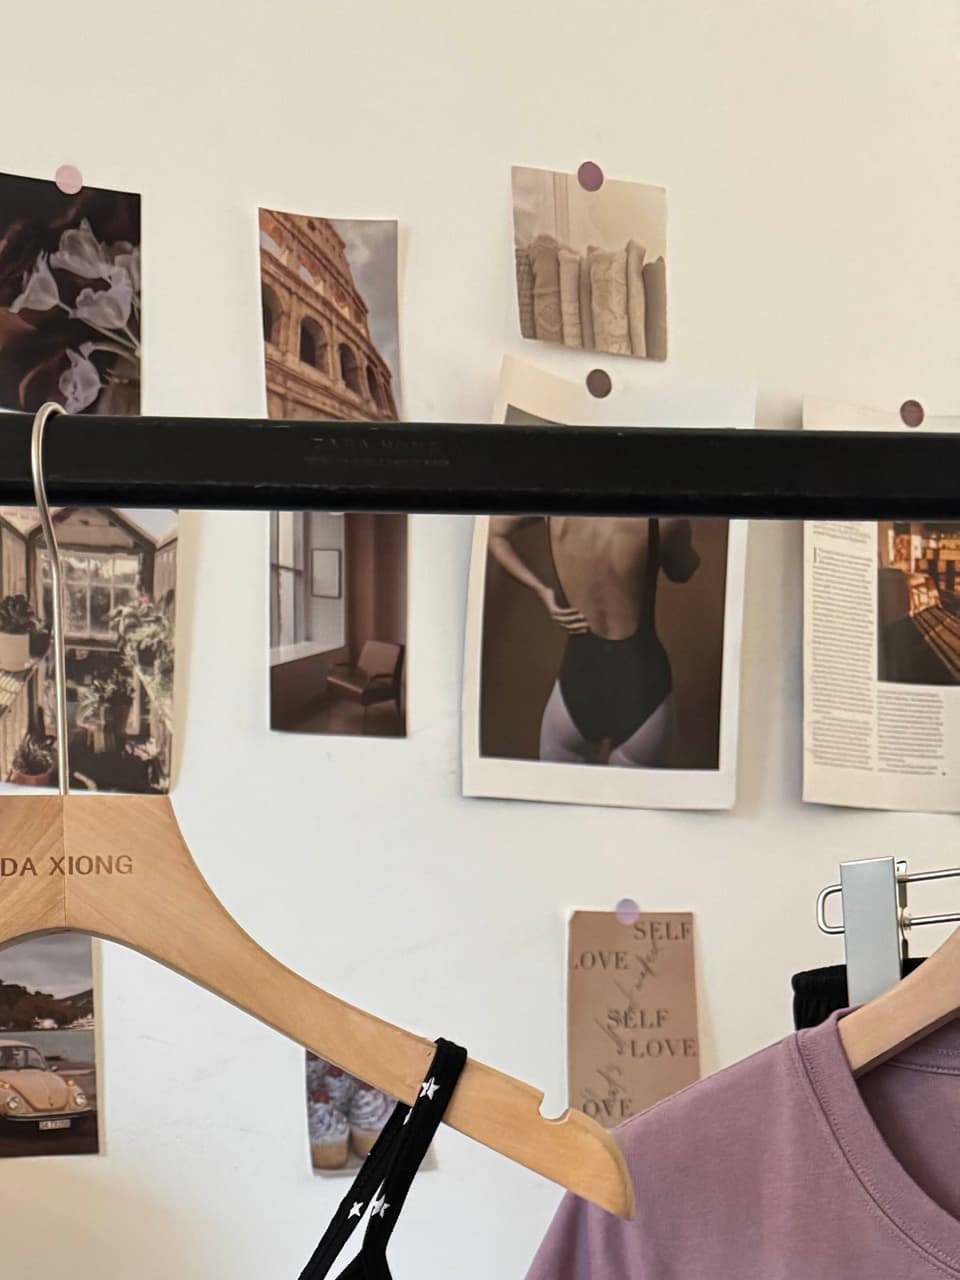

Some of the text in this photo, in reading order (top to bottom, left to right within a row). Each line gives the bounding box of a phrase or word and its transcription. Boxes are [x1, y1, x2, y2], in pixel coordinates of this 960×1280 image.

[0, 854, 134, 877] DA XIONG
[633, 921, 693, 940] SELF
[607, 1009, 670, 1030] SELF
[630, 1038, 698, 1059] LOVE
[581, 1097, 634, 1118] OVE
